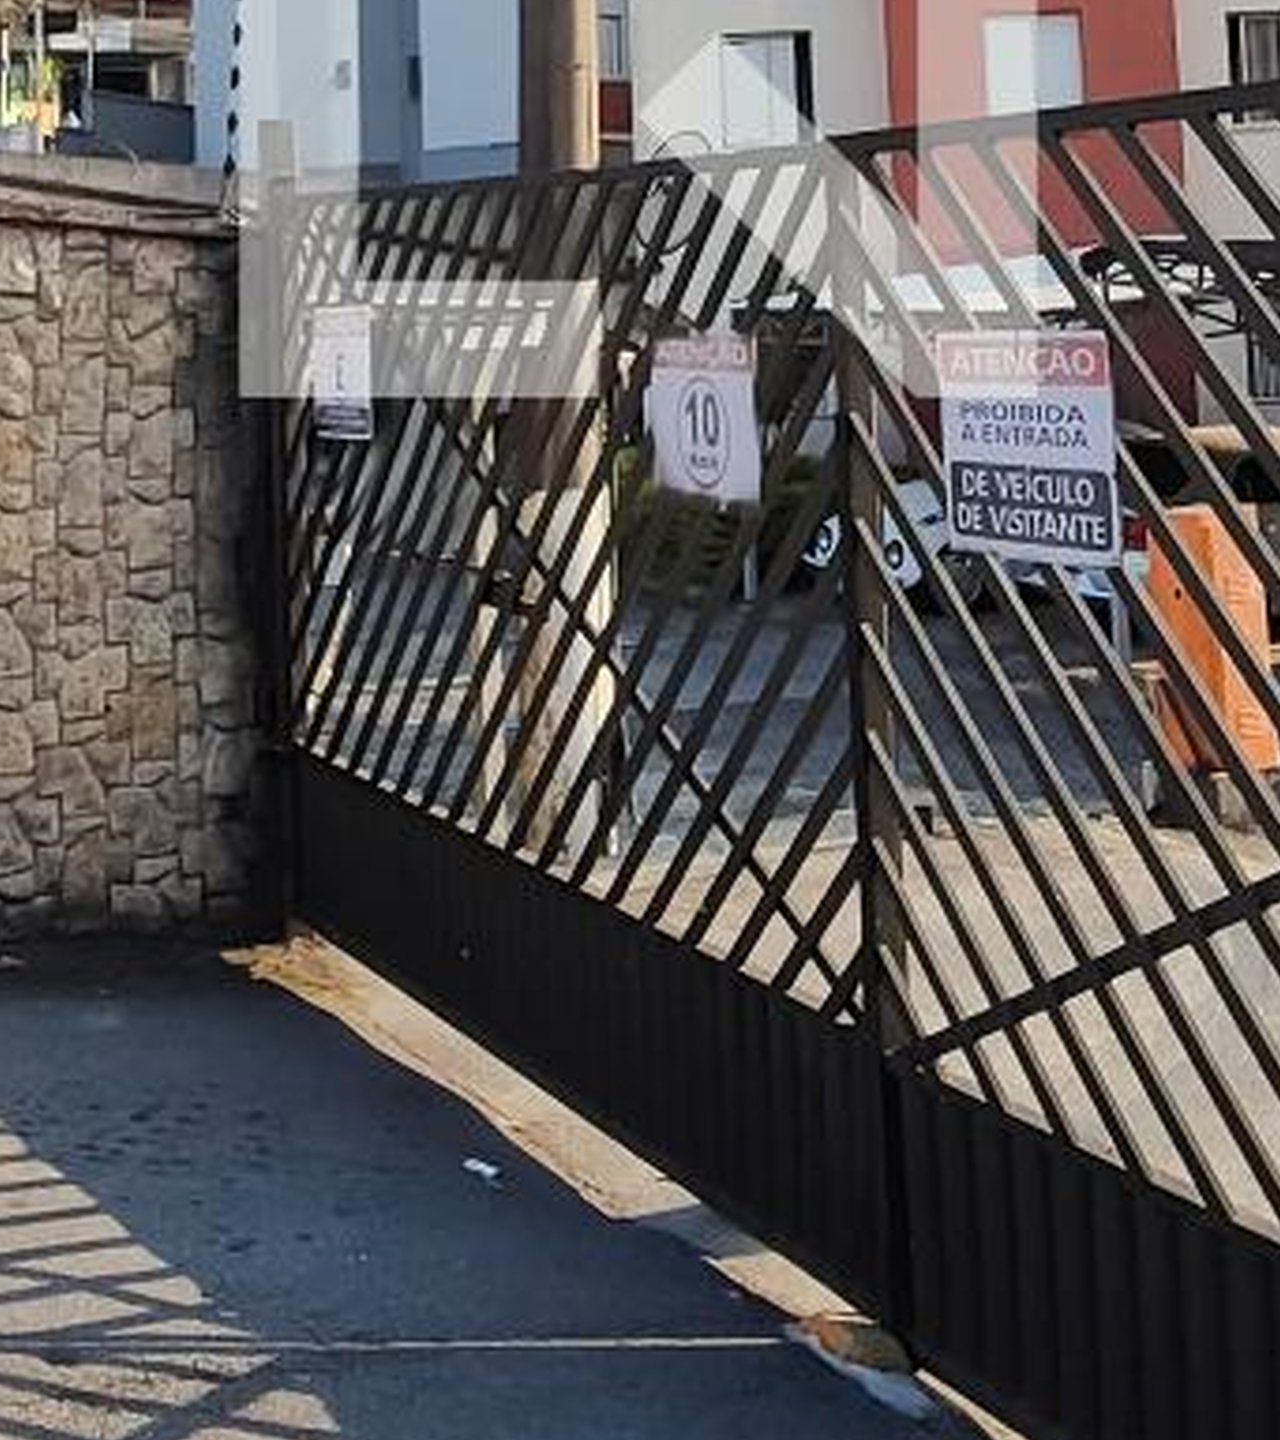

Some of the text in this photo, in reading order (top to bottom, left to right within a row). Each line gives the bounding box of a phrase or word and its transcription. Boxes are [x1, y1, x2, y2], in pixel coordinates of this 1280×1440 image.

[685, 390, 720, 447] 10
[959, 400, 1088, 425] PROIBIDA
[980, 424, 1092, 449] ENTRADA
[961, 468, 990, 497] DE
[957, 501, 1108, 546] DE VISITANTE
